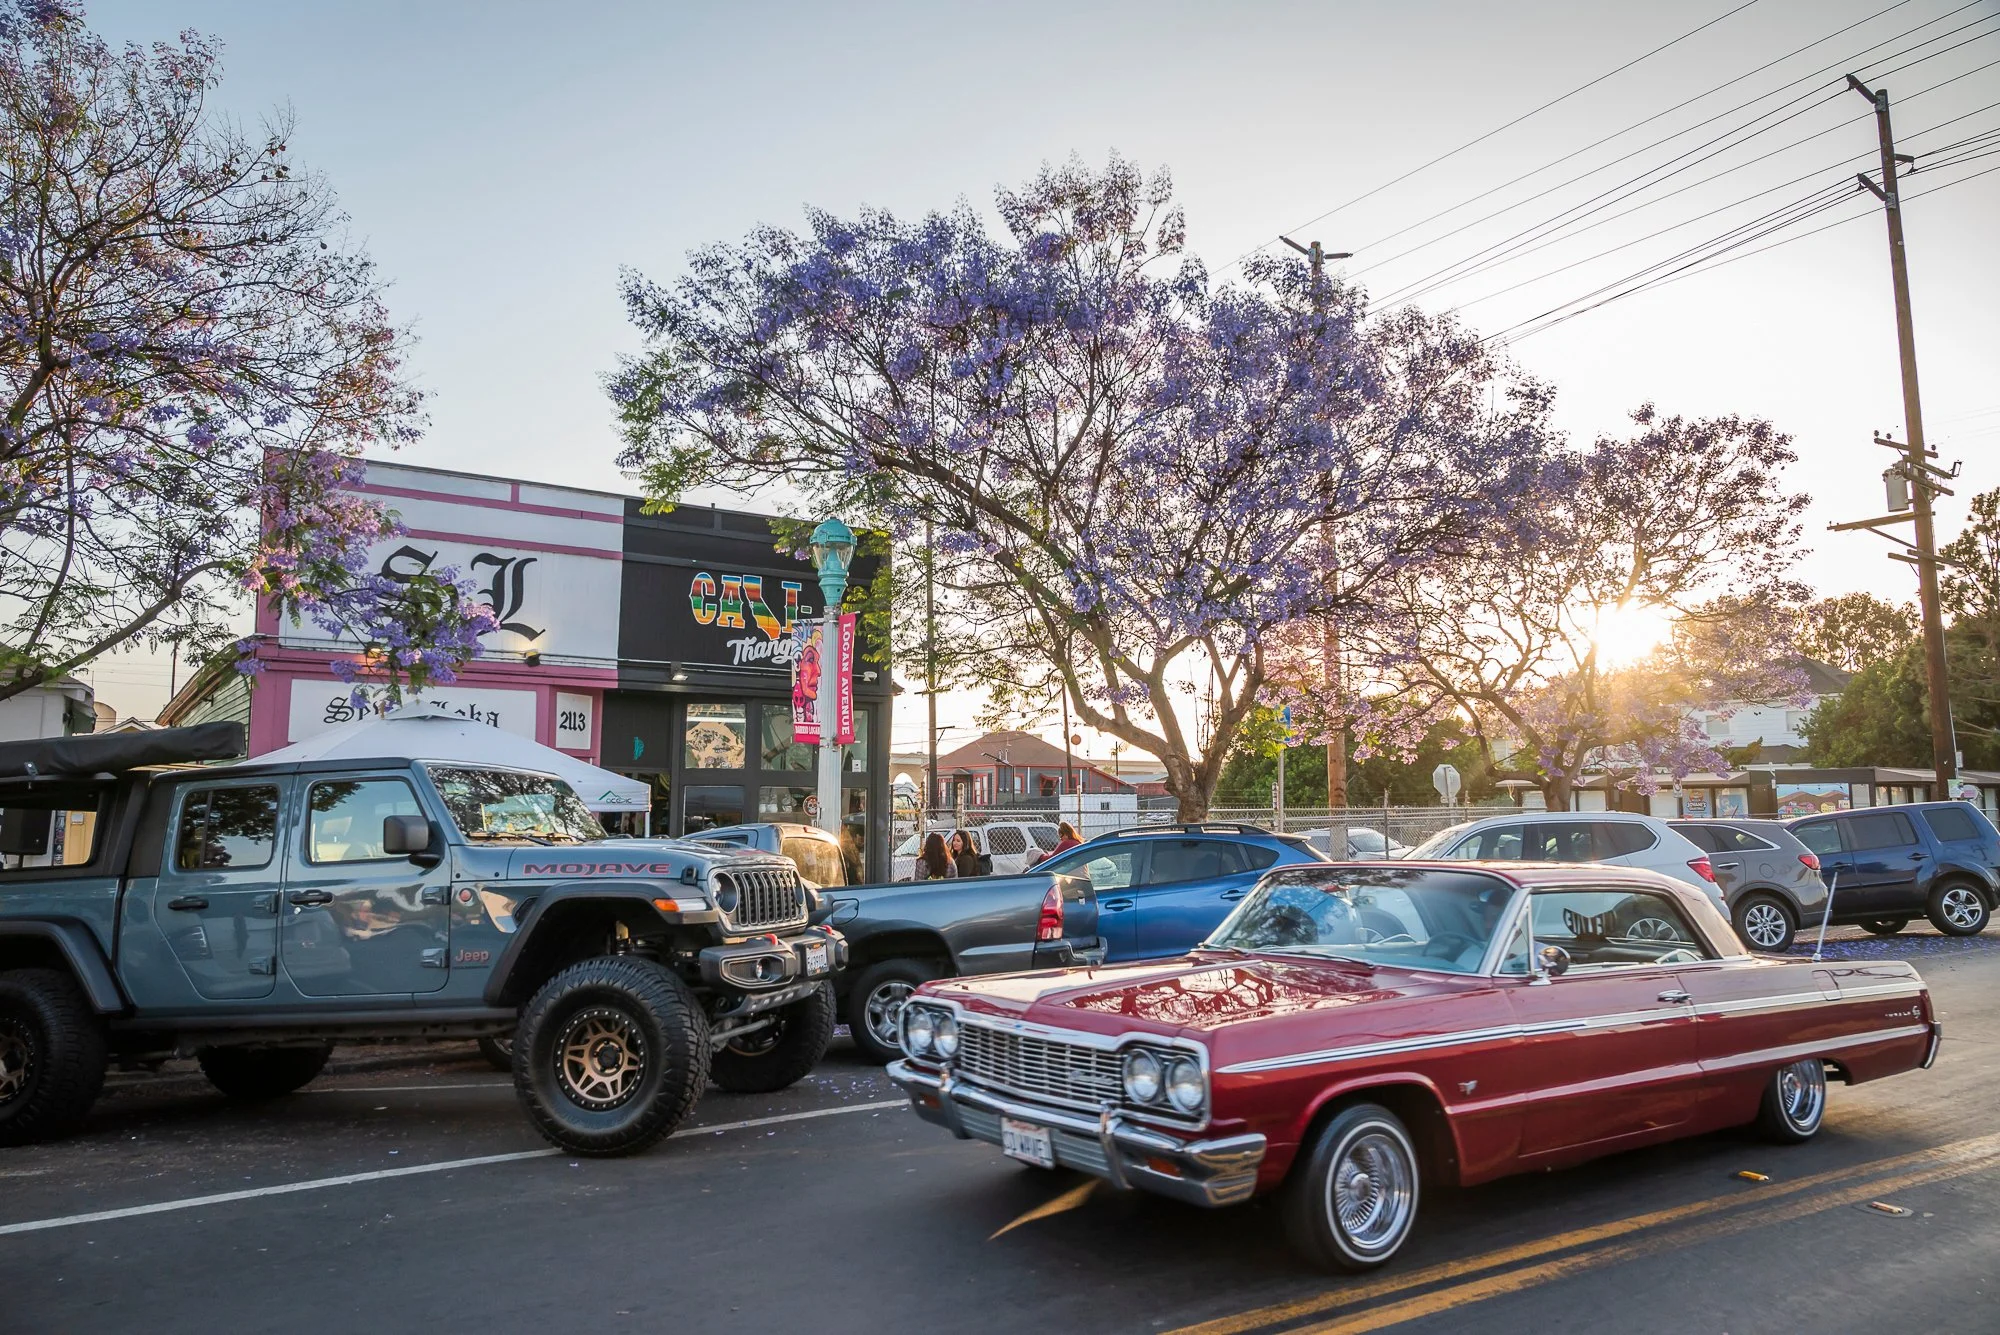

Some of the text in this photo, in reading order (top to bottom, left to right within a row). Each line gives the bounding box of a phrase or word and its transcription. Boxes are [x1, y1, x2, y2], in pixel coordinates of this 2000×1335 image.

[841, 622, 851, 736] LOGAN AVENUE
[559, 711, 586, 731] 2113
[523, 863, 671, 876] MOJAVE
[455, 949, 489, 966] Jeep
